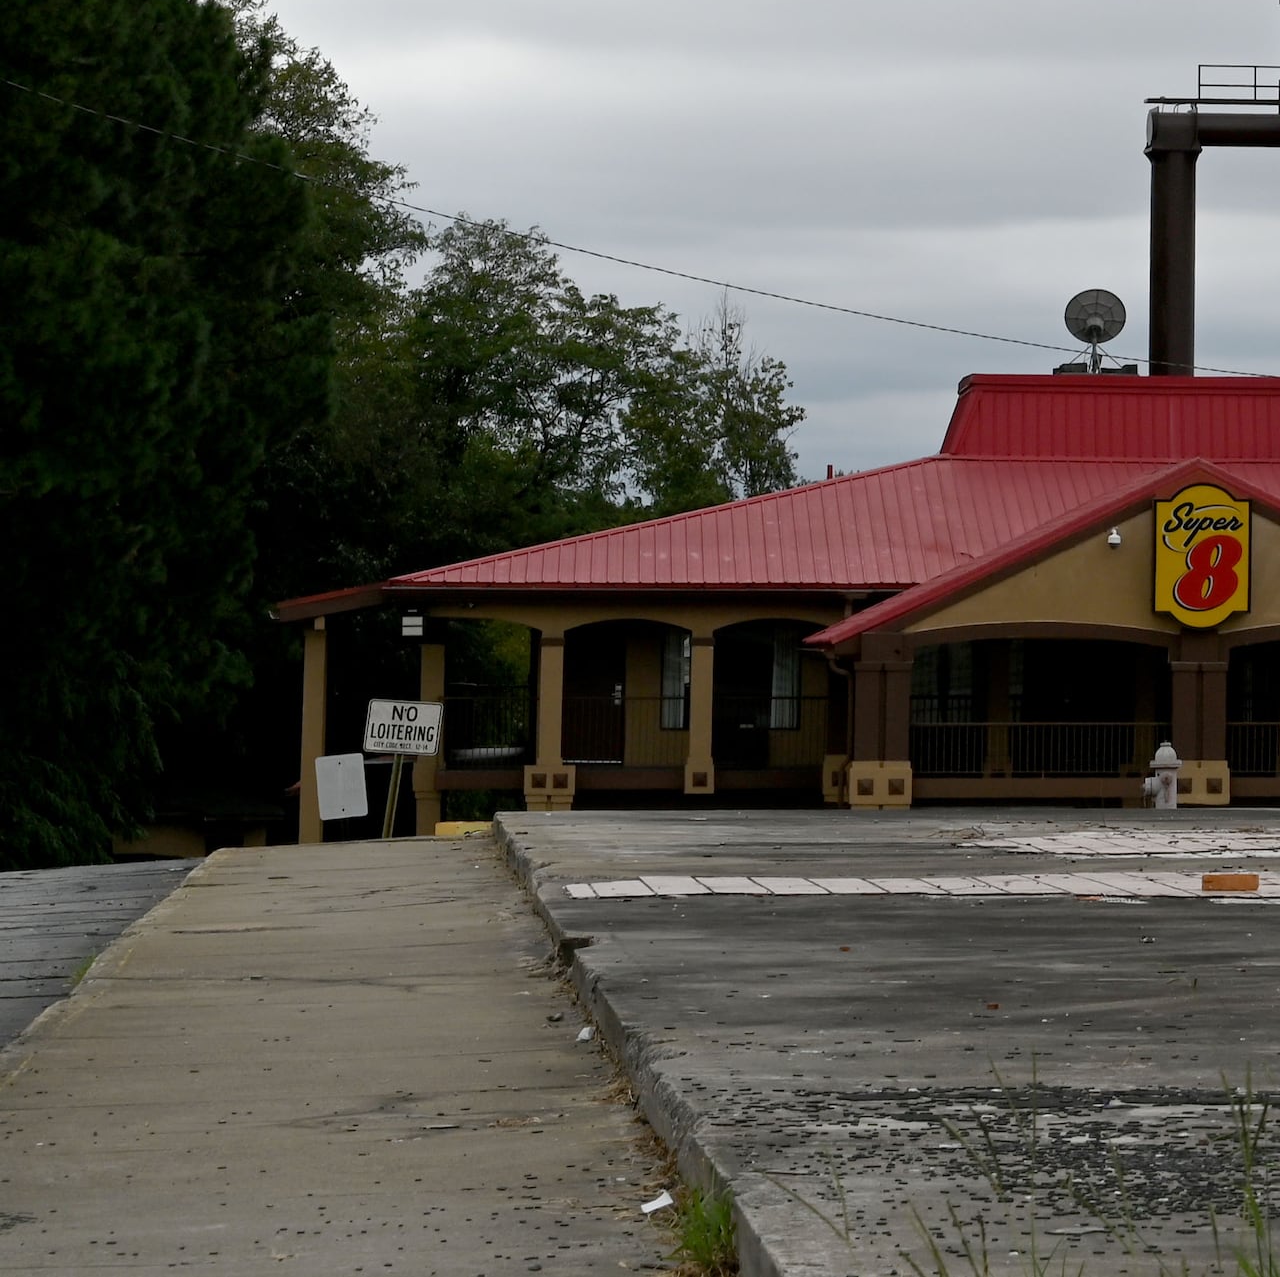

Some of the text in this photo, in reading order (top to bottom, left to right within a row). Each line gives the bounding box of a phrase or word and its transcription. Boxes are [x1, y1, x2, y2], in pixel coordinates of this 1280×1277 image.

[1164, 502, 1243, 548] Super
[1173, 535, 1243, 611] 8
[391, 705, 418, 722] NO
[370, 722, 435, 742] LOITERING
